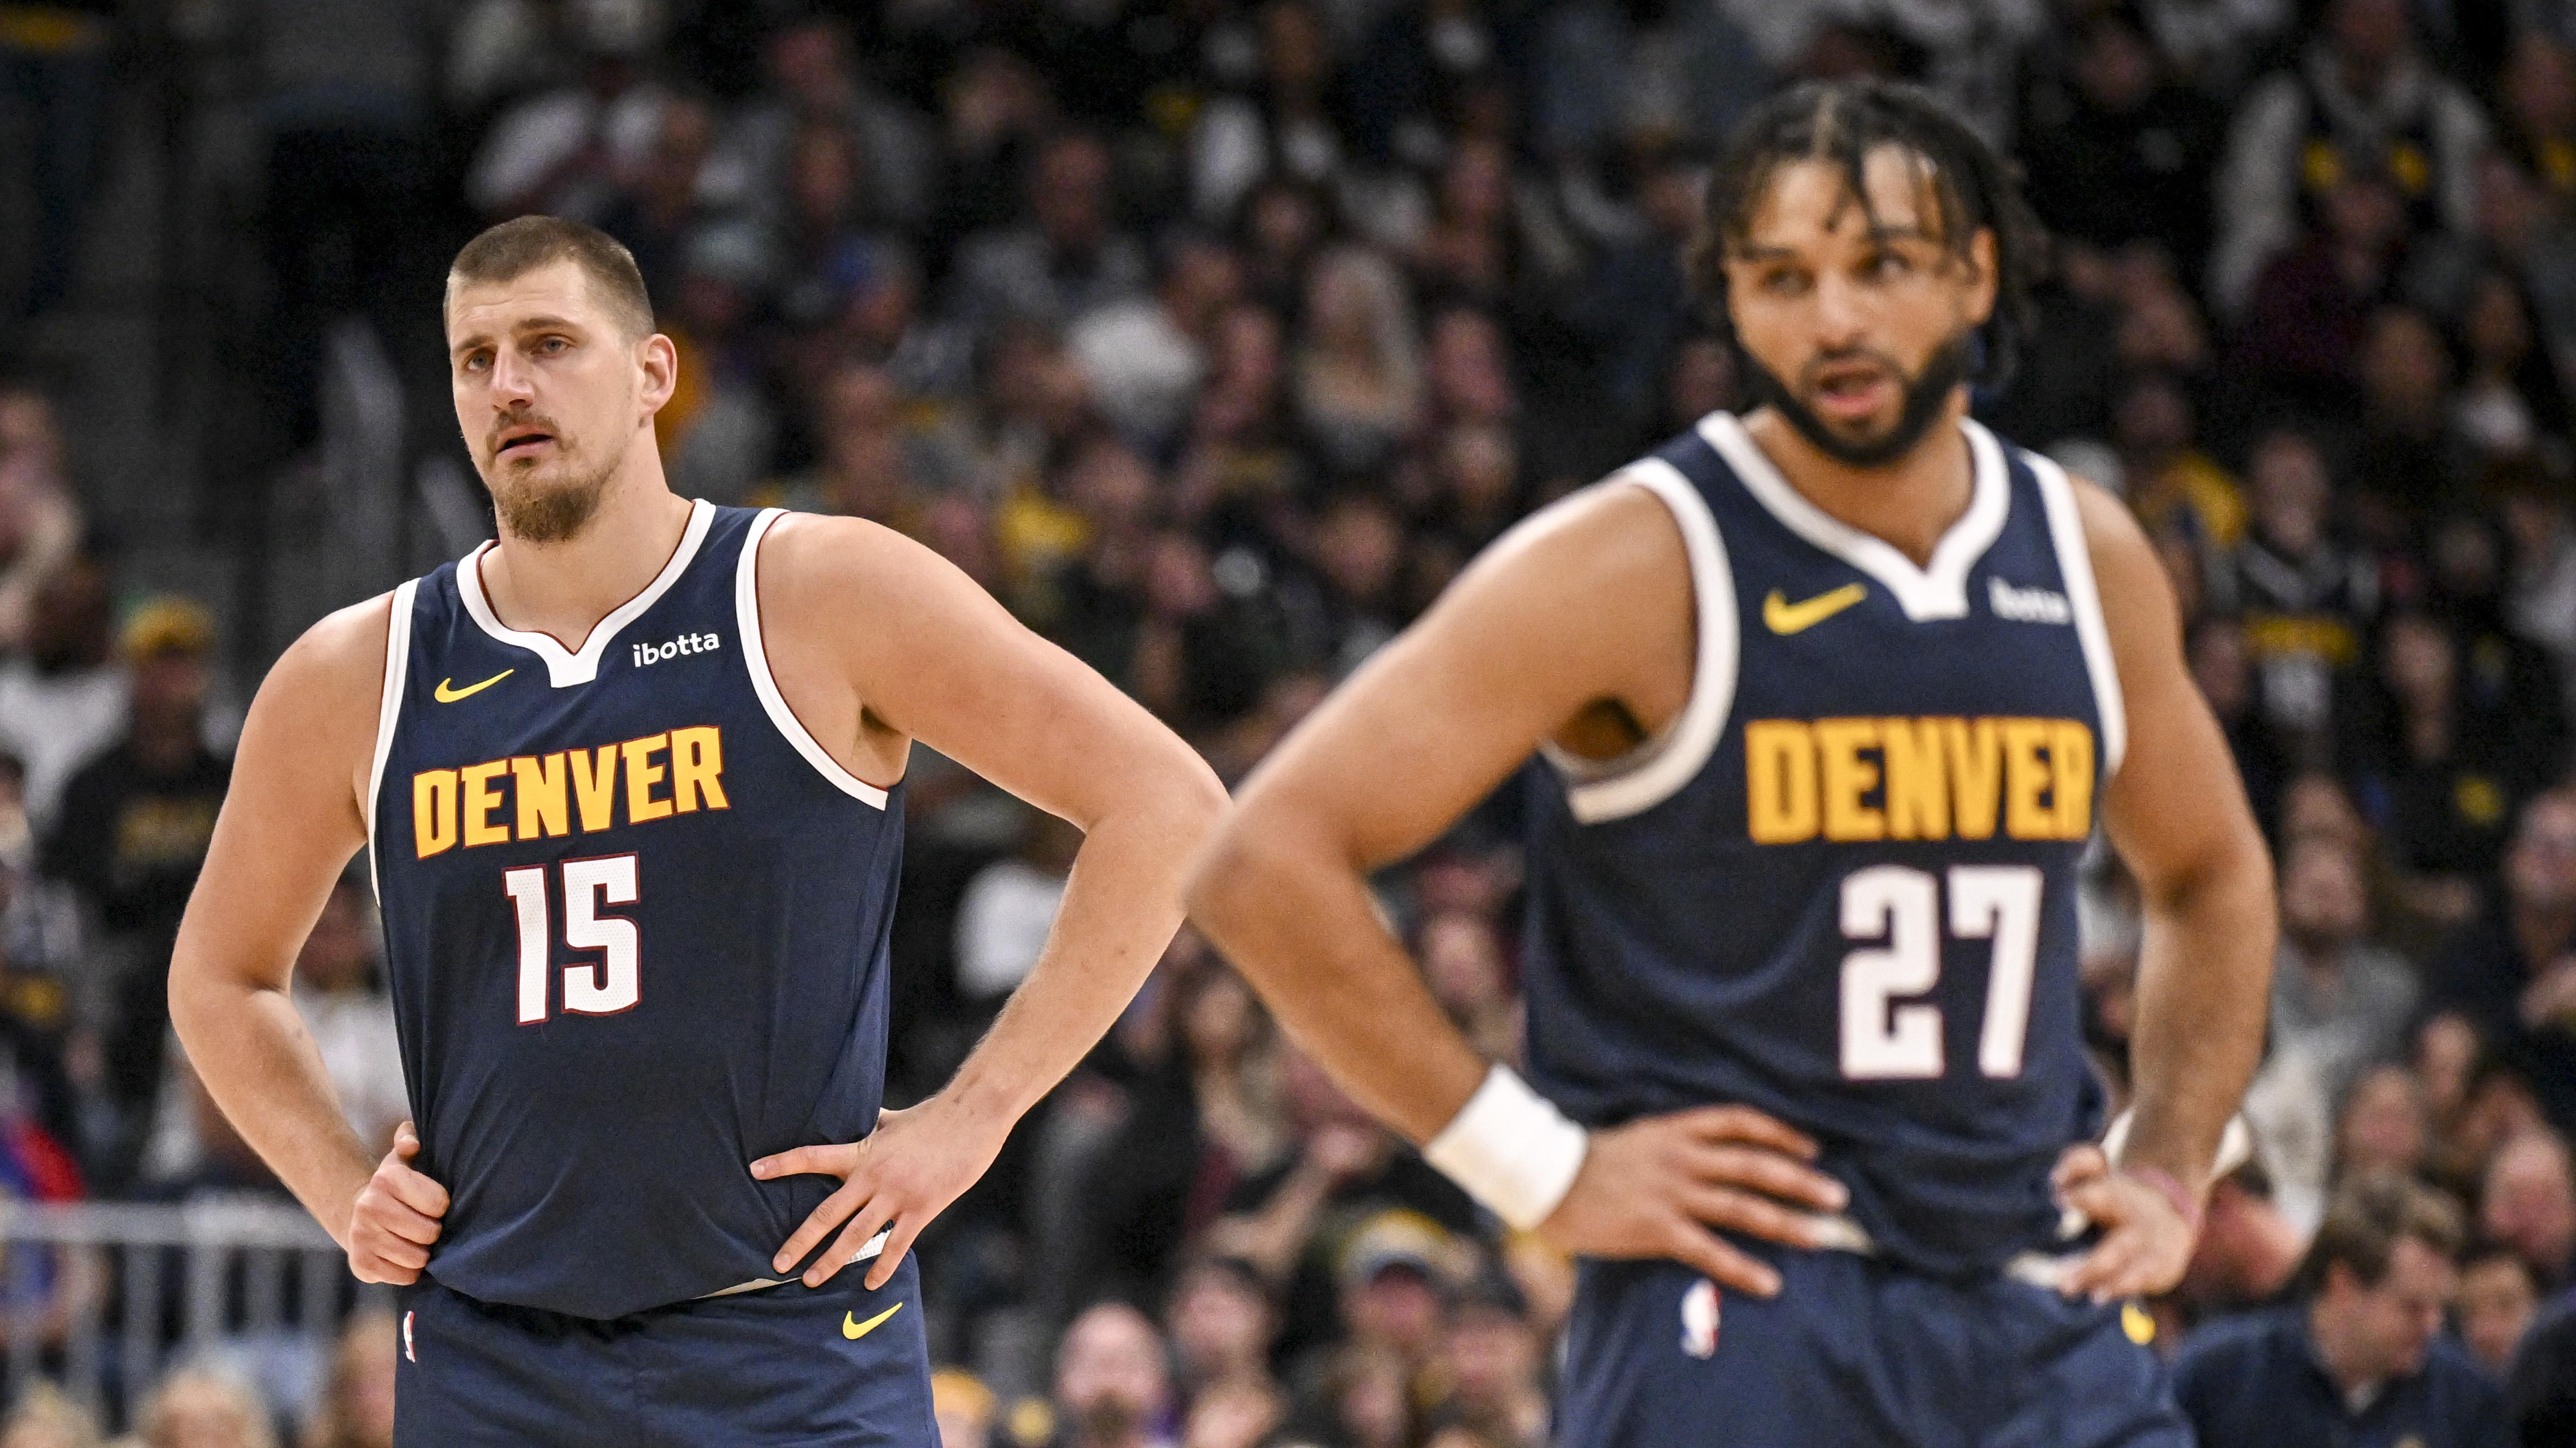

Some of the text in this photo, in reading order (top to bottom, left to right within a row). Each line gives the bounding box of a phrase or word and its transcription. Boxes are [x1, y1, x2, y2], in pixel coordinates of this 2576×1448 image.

[632, 632, 720, 667] ibotta
[413, 726, 731, 859] DENVER
[1745, 716, 2094, 843] DENVER
[503, 852, 642, 1025] 15
[1839, 864, 2044, 1078] 27
